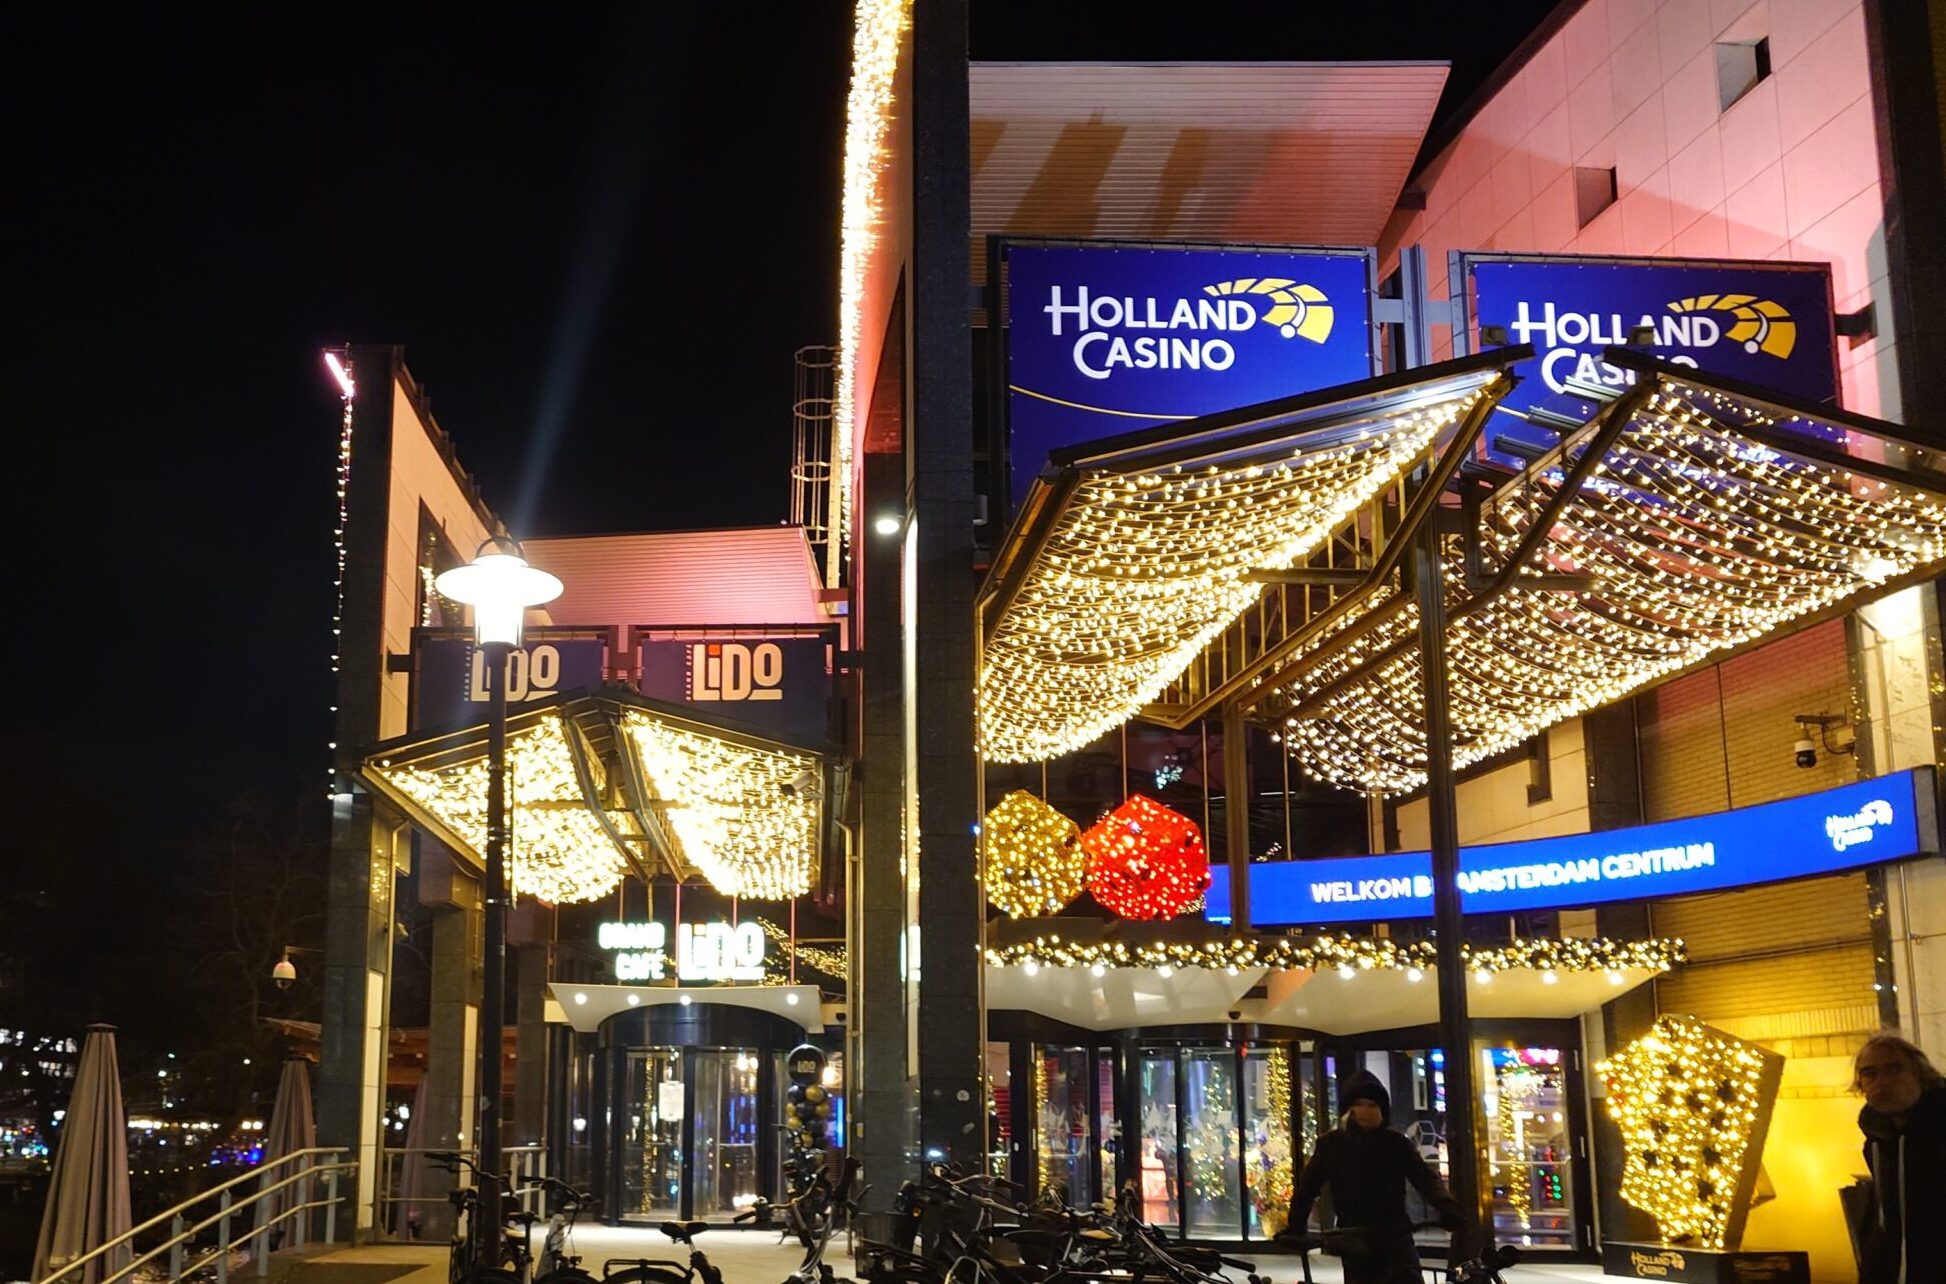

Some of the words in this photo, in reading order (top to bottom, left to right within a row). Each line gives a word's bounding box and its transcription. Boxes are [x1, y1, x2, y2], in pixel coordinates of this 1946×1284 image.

[1043, 285, 1257, 336] HOLLAND
[1072, 331, 1236, 379] CASINO
[470, 644, 560, 702] LDO
[1311, 877, 1412, 904] WELKOM
[1601, 842, 1716, 880] CENTRUM
